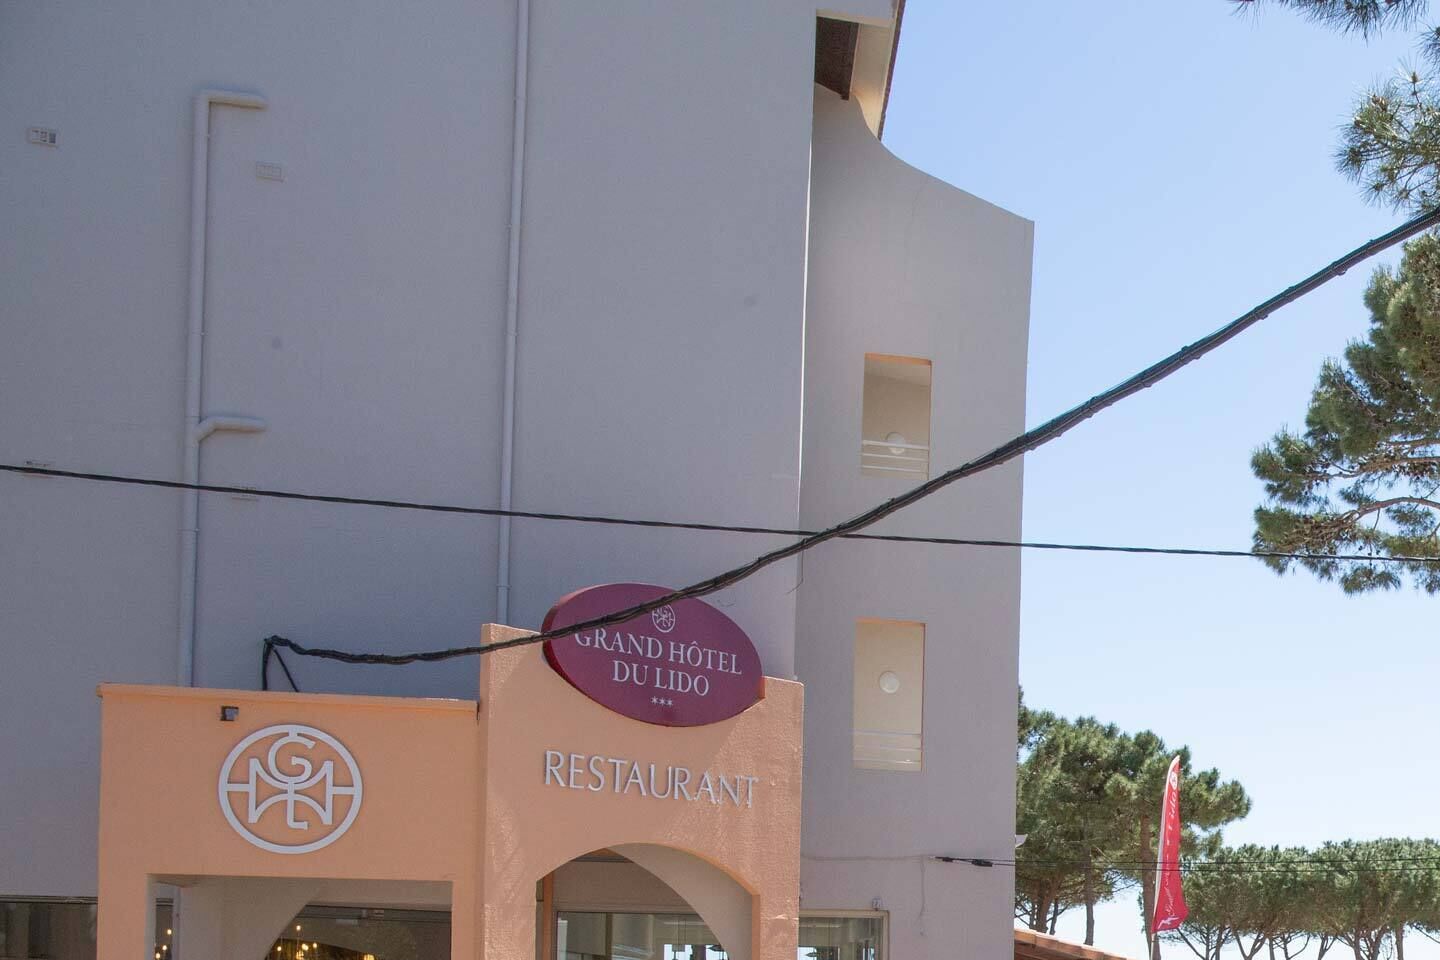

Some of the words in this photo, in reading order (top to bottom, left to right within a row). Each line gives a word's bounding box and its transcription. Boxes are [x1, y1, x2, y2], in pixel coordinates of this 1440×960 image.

[575, 627, 663, 659] GRAND
[669, 641, 742, 675] HÔTEL
[613, 660, 648, 685] DU
[655, 667, 710, 696] LIDO
[545, 750, 759, 808] RESTAURANT
